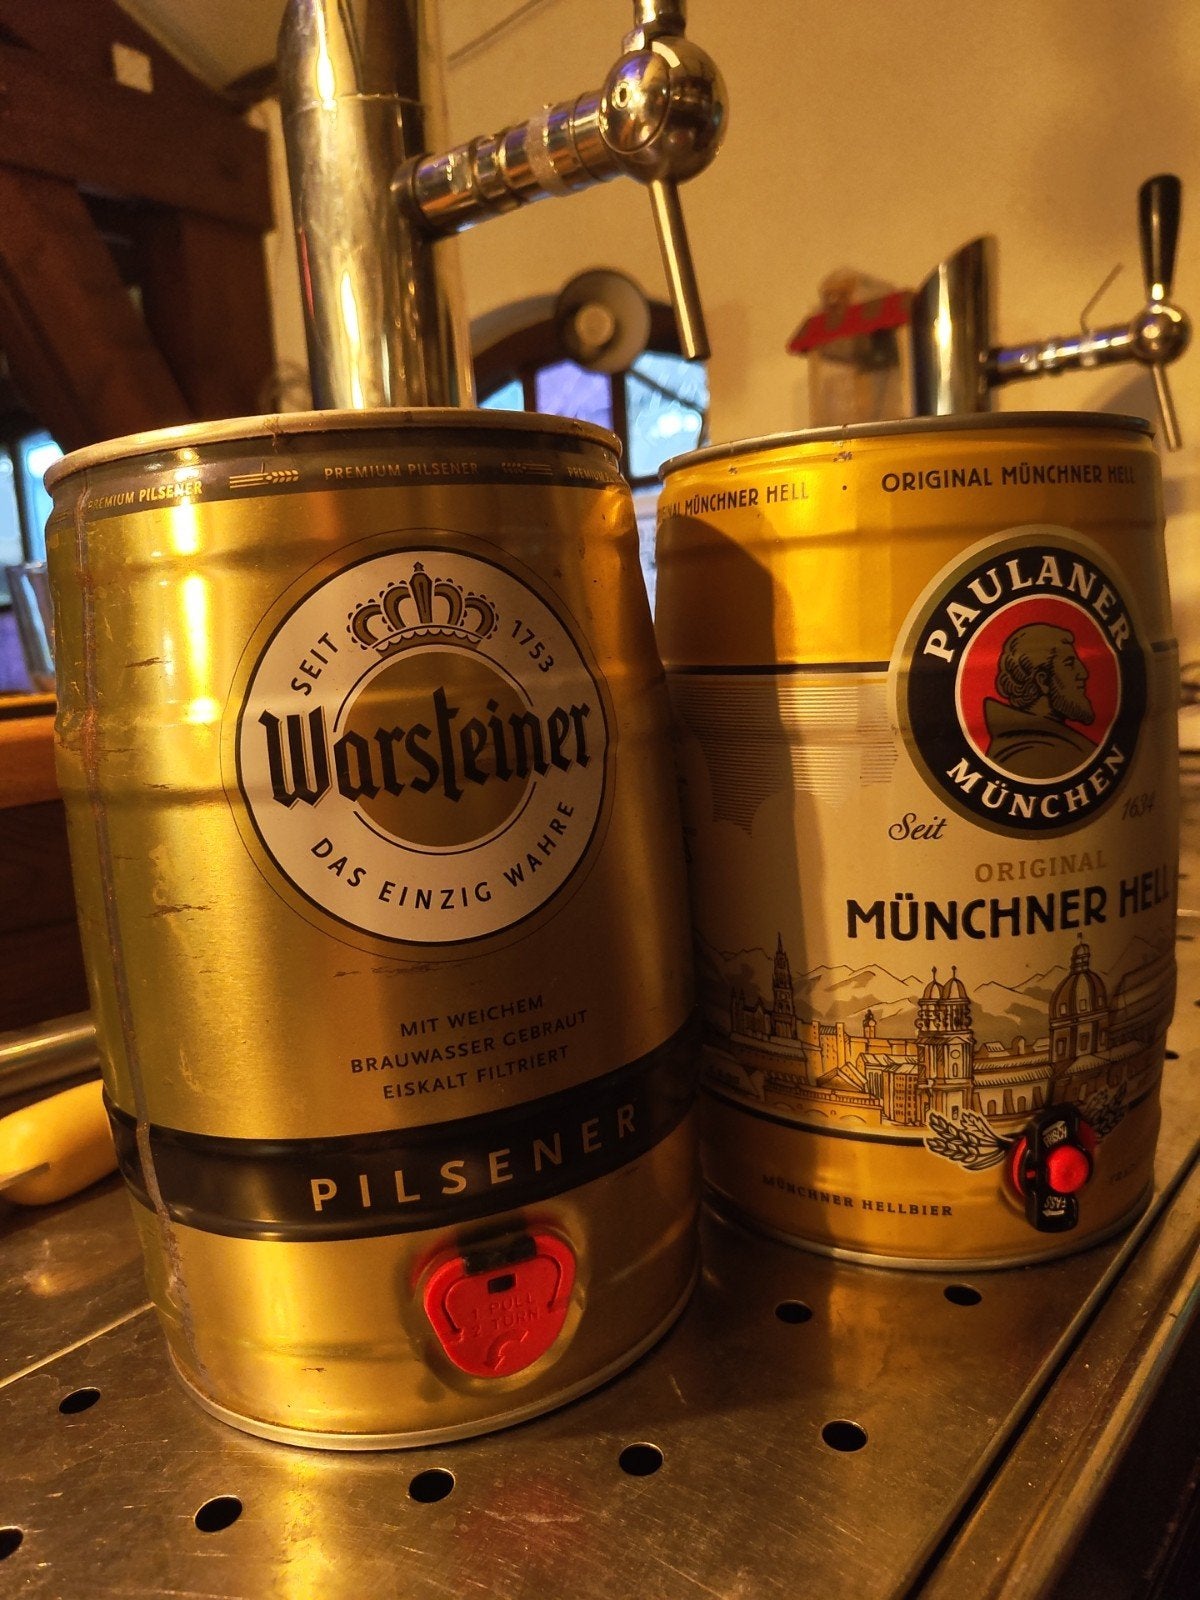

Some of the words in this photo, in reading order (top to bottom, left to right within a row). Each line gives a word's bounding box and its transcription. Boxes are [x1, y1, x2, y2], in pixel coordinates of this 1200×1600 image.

[324, 464, 401, 480] PREMIUM
[407, 462, 479, 476] PILSENER
[881, 467, 993, 493] ORIGINAL
[1001, 463, 1103, 486] MÜNCHNER
[1107, 465, 1136, 485] HELL
[87, 492, 135, 510] PREMIUM
[138, 481, 203, 502] PILSENER
[684, 488, 759, 516] MÜNCHNER
[766, 482, 809, 503] HELL
[923, 555, 1132, 663] PAULANER
[291, 632, 339, 696] SEIT
[511, 619, 554, 673] 1753
[258, 686, 591, 810] Warsteiner
[946, 745, 1126, 819] MÜNCHEN
[888, 813, 948, 841] Seit
[1121, 792, 1156, 821] 1634
[311, 837, 367, 888] DAS
[378, 880, 492, 910] EINZIG
[503, 801, 575, 888] WAHRE
[974, 850, 1107, 883] ORIGINAL
[847, 885, 1107, 941] MÜNCHNER
[1119, 864, 1169, 918] HELL
[400, 1017, 440, 1037] MIT
[447, 995, 544, 1029] WEICHEM
[351, 1037, 495, 1073] BRAUWASSER
[502, 1010, 588, 1047] GEBRAUT
[383, 1072, 469, 1099] EISKALT
[476, 1045, 570, 1083] FILTRIERT
[310, 1103, 636, 1212] PILSENER
[762, 1174, 854, 1208] MÜNCHNER
[862, 1200, 953, 1217] HELLBIER
[491, 1310, 541, 1331] TURN
